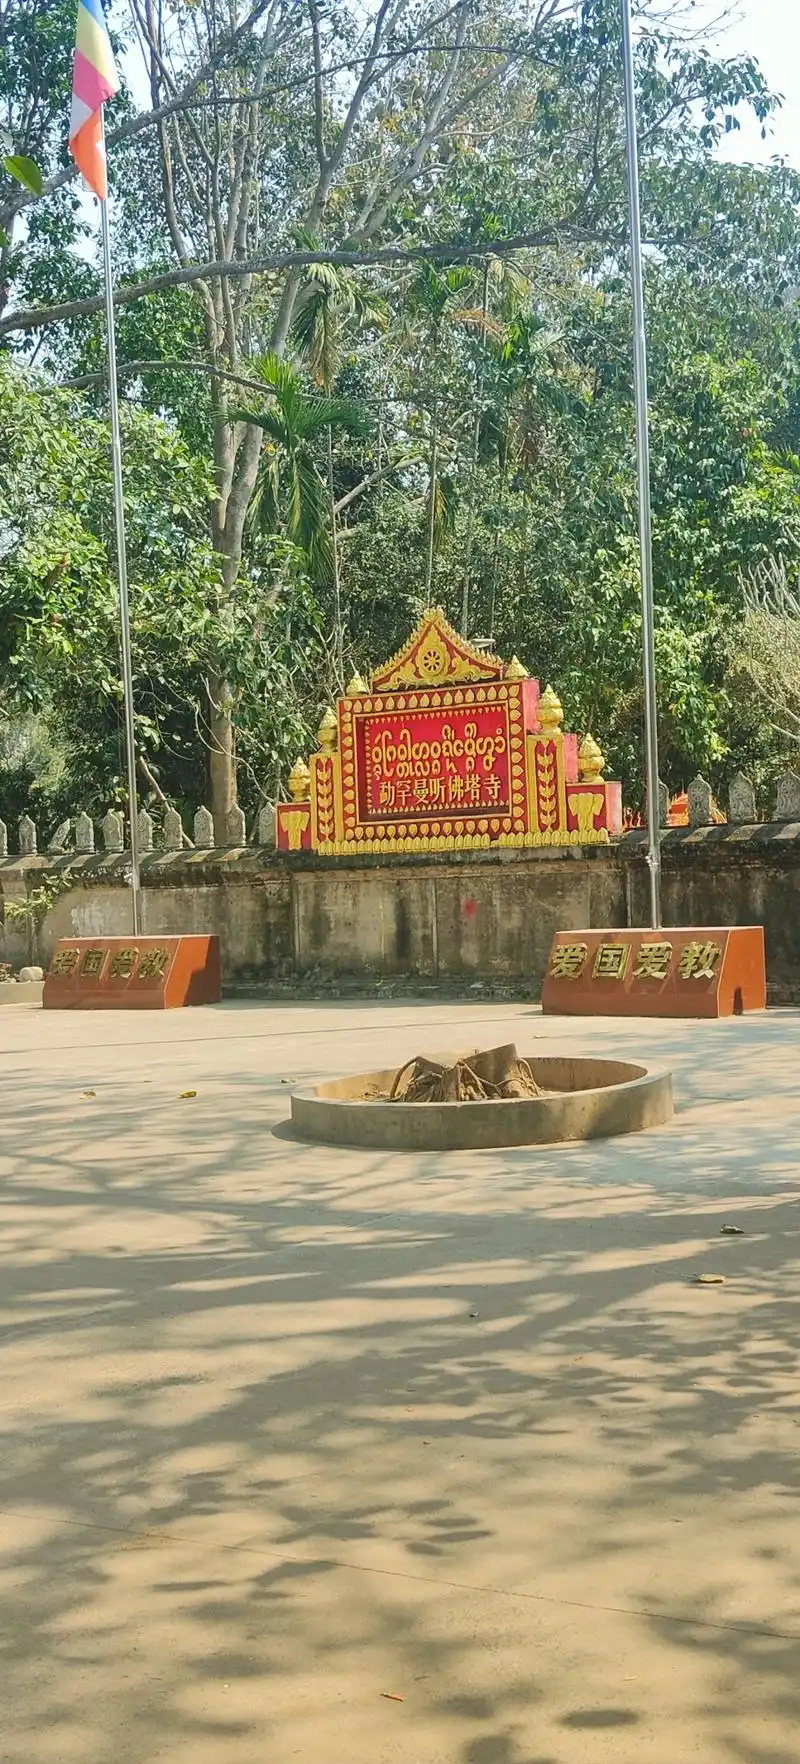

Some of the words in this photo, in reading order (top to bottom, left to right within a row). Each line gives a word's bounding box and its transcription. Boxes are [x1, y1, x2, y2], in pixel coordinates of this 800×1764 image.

[379, 774, 502, 806] 勐罕曼听佛塔寺
[53, 947, 169, 979] 爱国爱教
[551, 941, 721, 980] 爱国爱教
